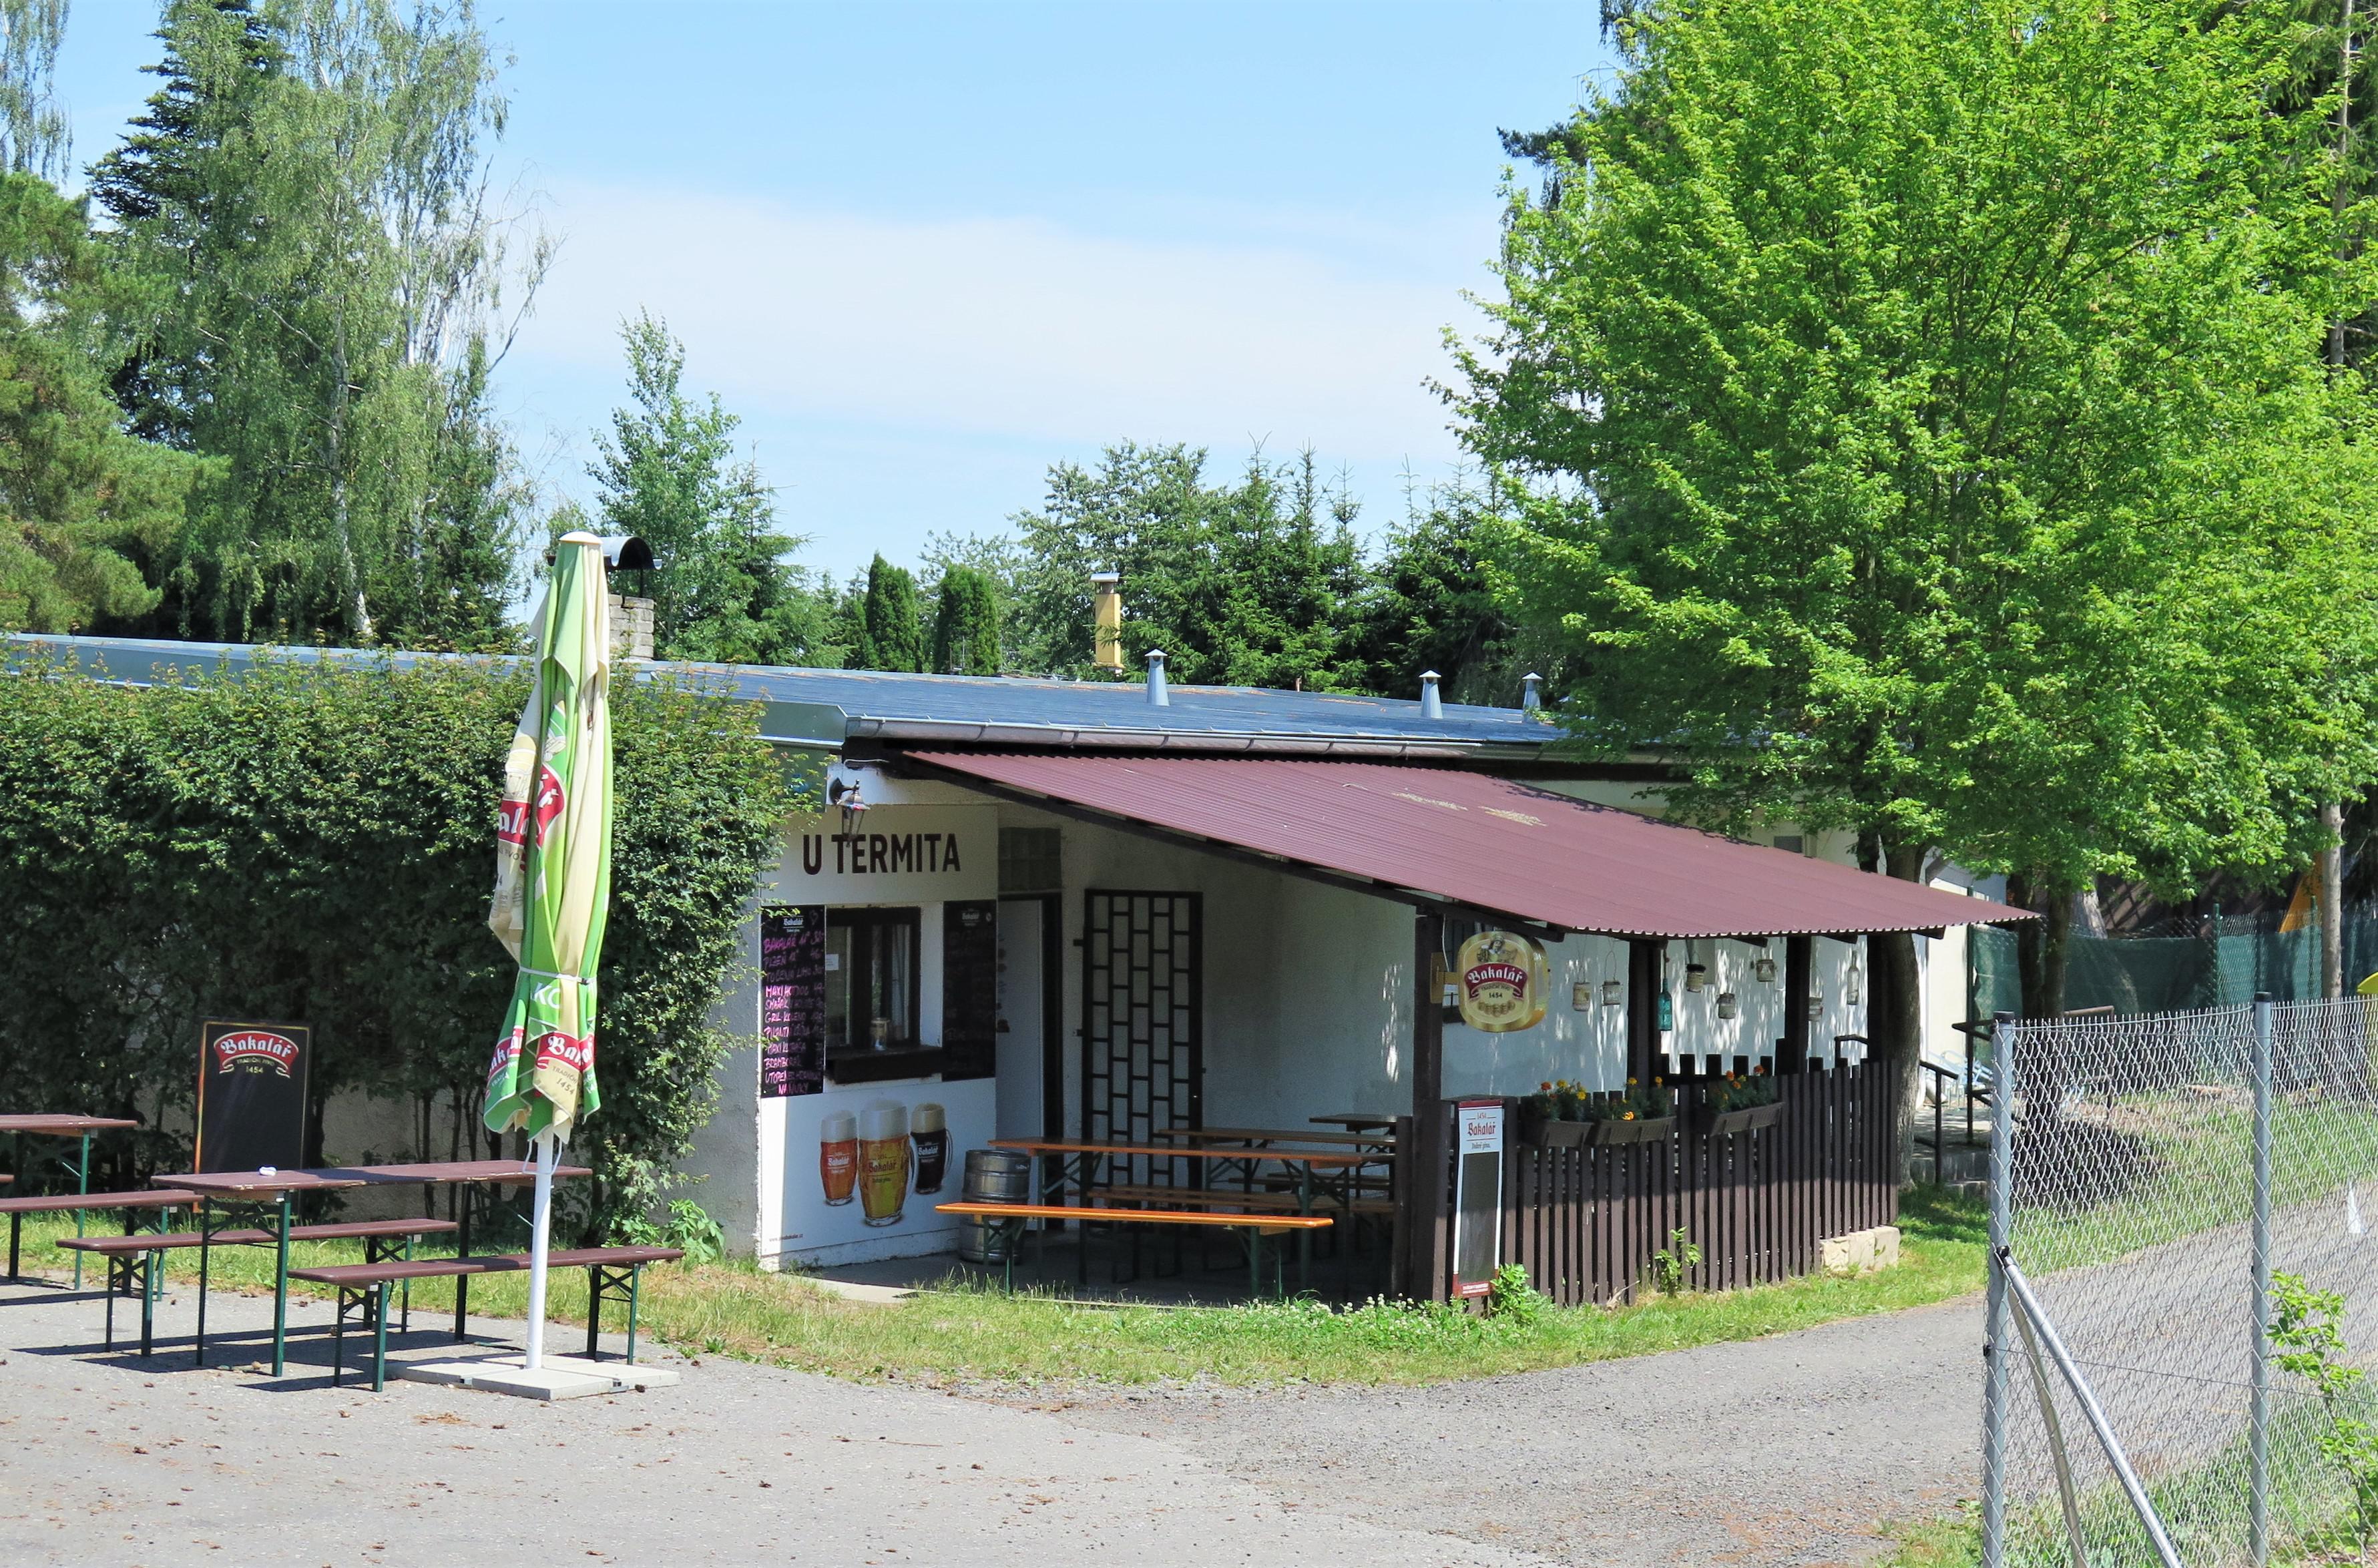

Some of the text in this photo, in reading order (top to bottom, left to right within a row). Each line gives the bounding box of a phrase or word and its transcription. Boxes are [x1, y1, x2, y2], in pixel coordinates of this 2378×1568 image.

[803, 833, 961, 875] U TERMITA
[1468, 967, 1523, 983] Bakalář
[220, 1035, 292, 1057] Bakalář
[246, 1066, 264, 1074] 1454
